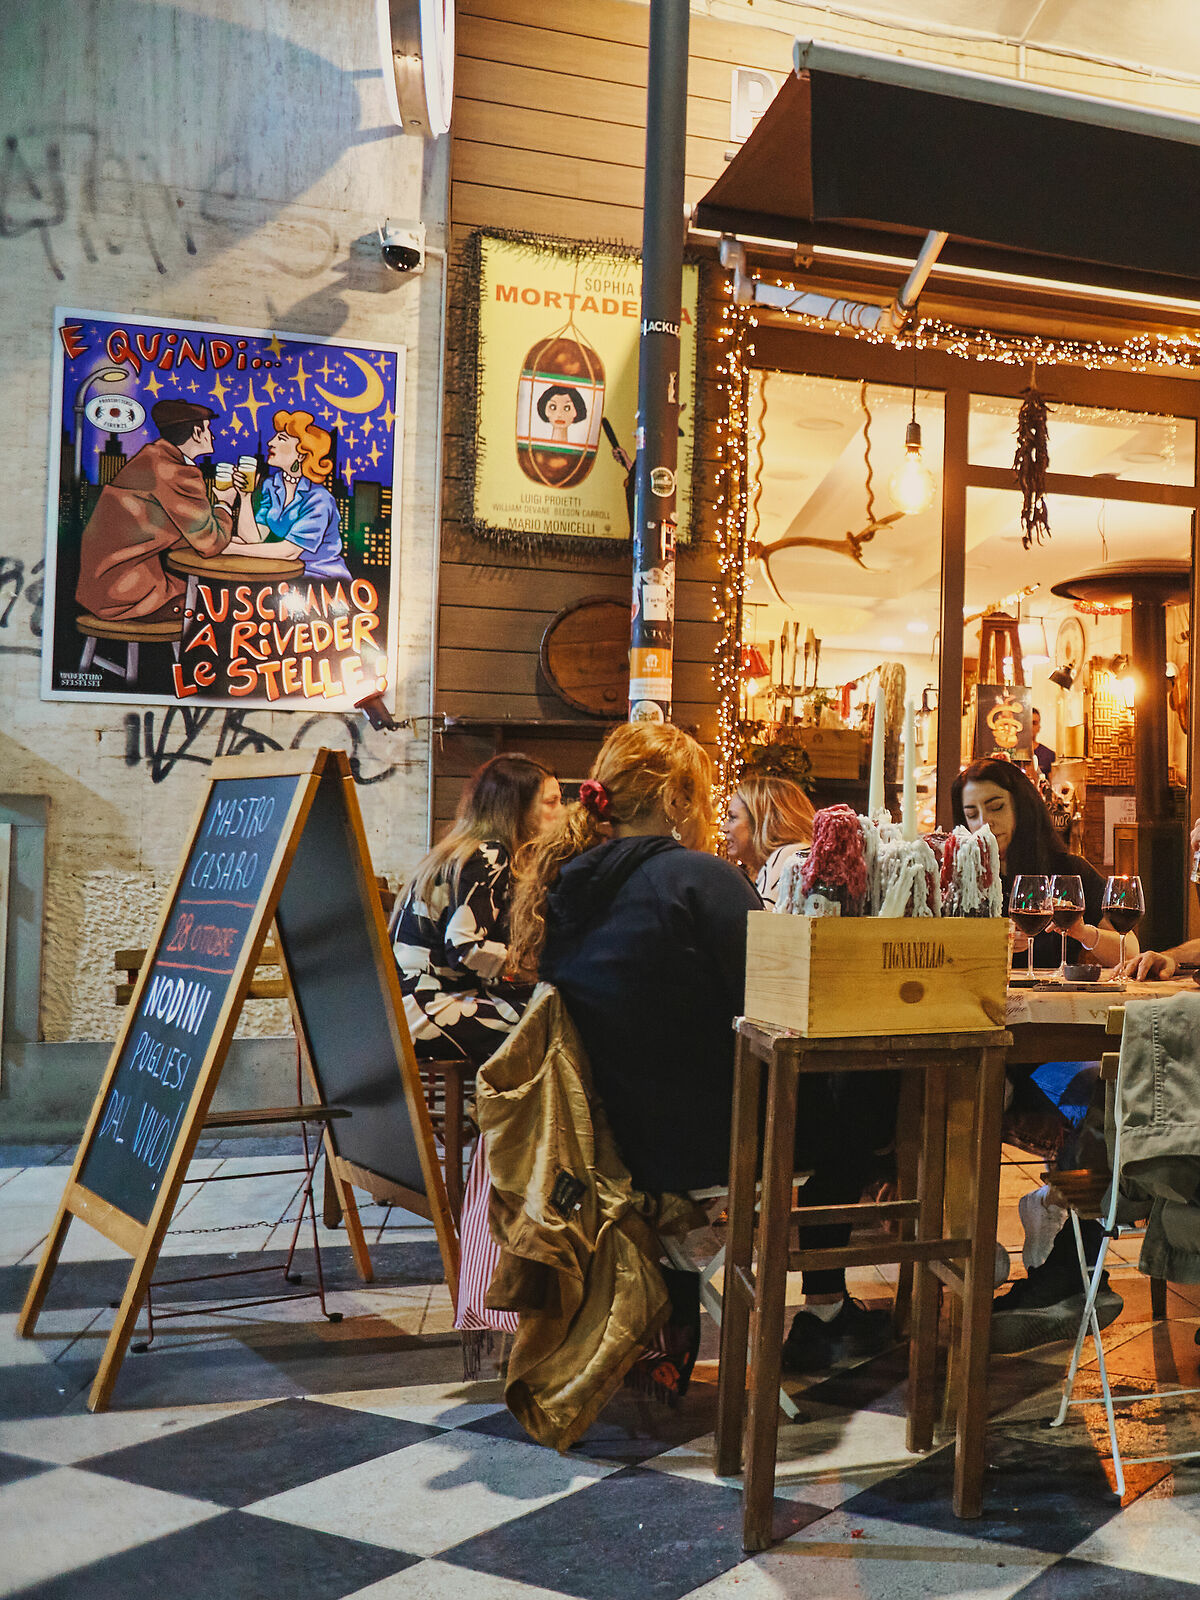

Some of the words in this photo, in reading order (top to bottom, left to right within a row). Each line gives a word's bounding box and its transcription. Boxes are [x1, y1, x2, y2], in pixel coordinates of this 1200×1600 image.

[585, 278, 635, 296] SOPHIA
[59, 325, 88, 360] E
[520, 494, 542, 505] LUIGI
[544, 495, 581, 507] PROIETTI
[508, 518, 541, 531] MARIO
[543, 520, 596, 534] MONICELLI
[184, 623, 220, 657] A
[207, 795, 275, 839] MASTRO
[190, 851, 259, 891] CASARO
[166, 913, 195, 952] 28
[143, 975, 212, 1036] NODINI
[129, 1031, 192, 1091] PUGLIESI
[99, 1088, 133, 1144] DAL
[133, 1102, 185, 1191] VIVO!
